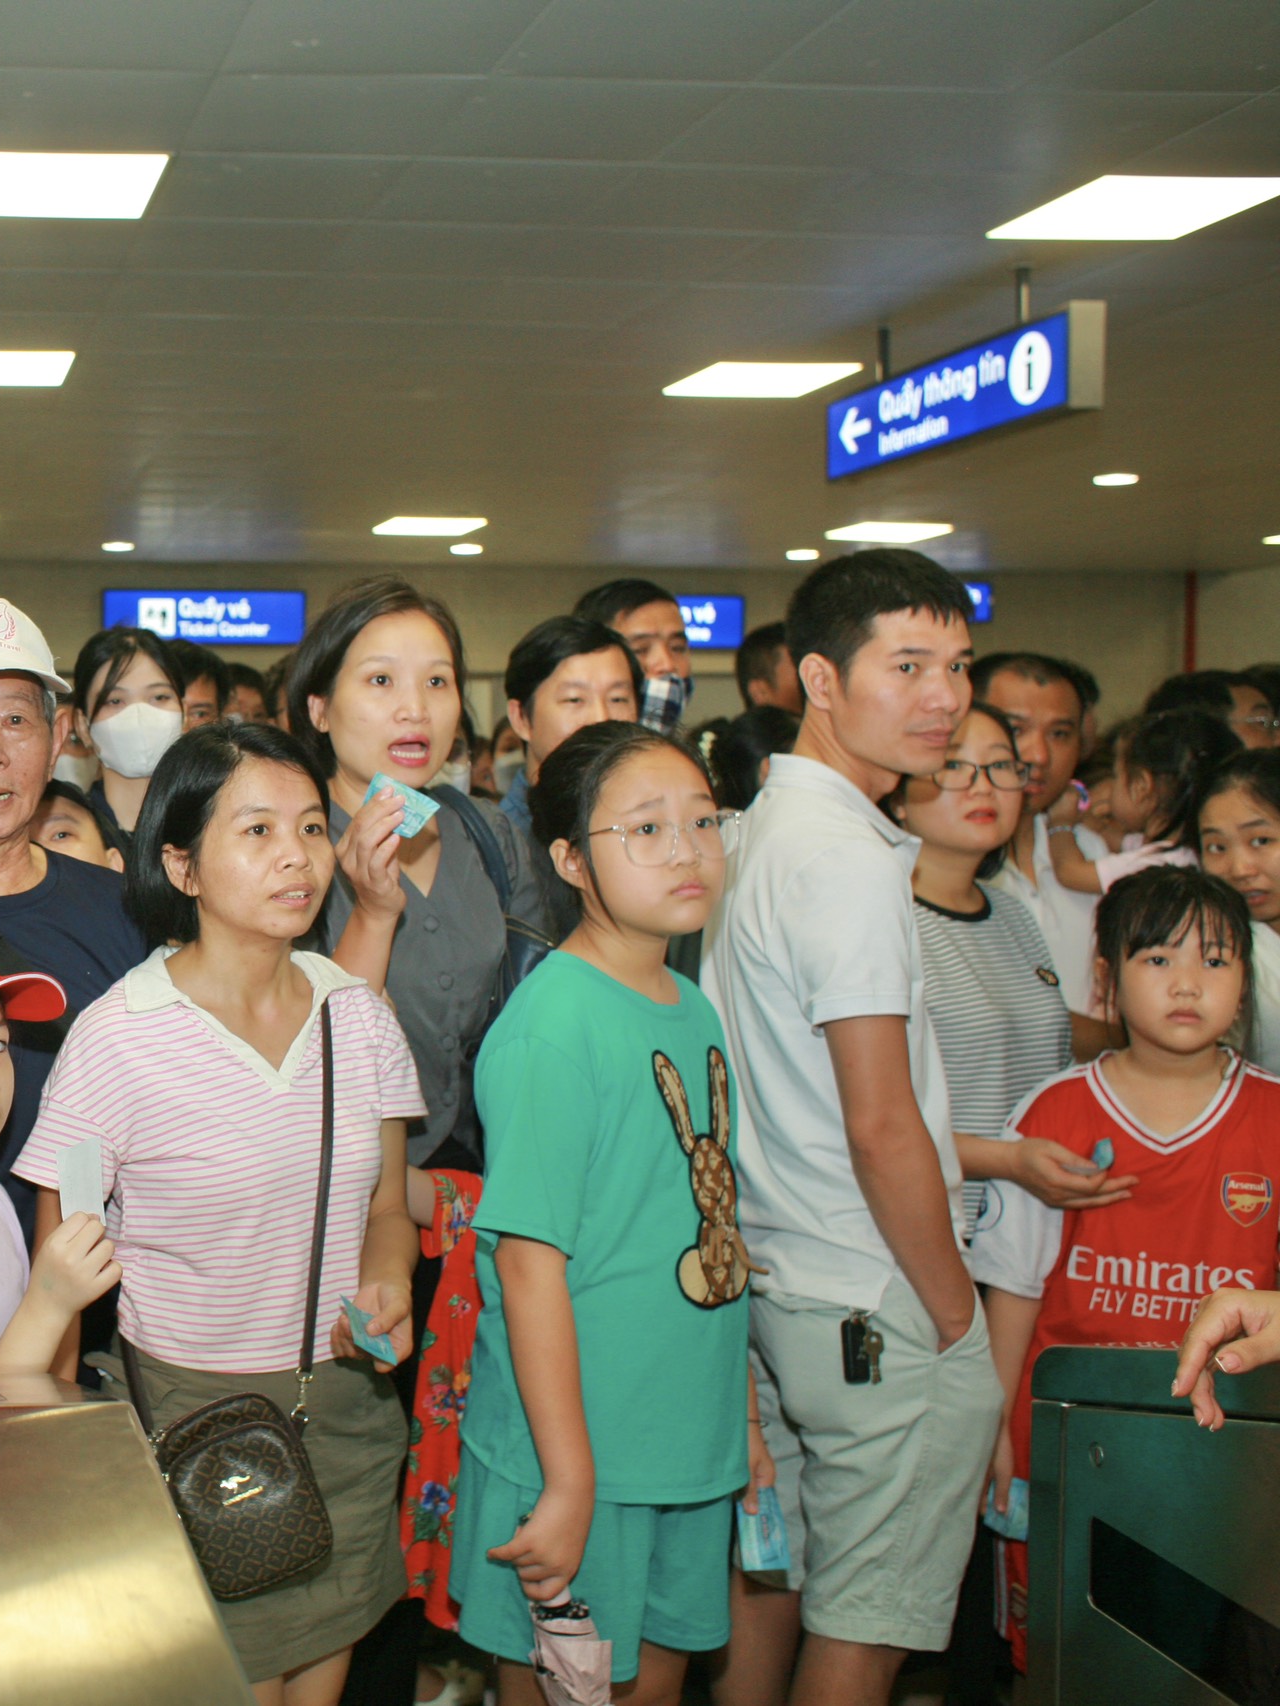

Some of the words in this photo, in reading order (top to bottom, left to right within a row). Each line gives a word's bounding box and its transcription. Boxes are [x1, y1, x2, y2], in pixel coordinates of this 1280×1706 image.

[923, 371, 977, 408] thông
[978, 350, 1006, 388] tin
[878, 414, 949, 456] Information
[178, 620, 219, 637] Ticket
[218, 620, 271, 637] Counter
[1228, 1179, 1265, 1191] Arsenal
[1066, 1244, 1255, 1294] Emirates
[1089, 1287, 1128, 1314] FLY
[1131, 1292, 1201, 1323] BETTE
